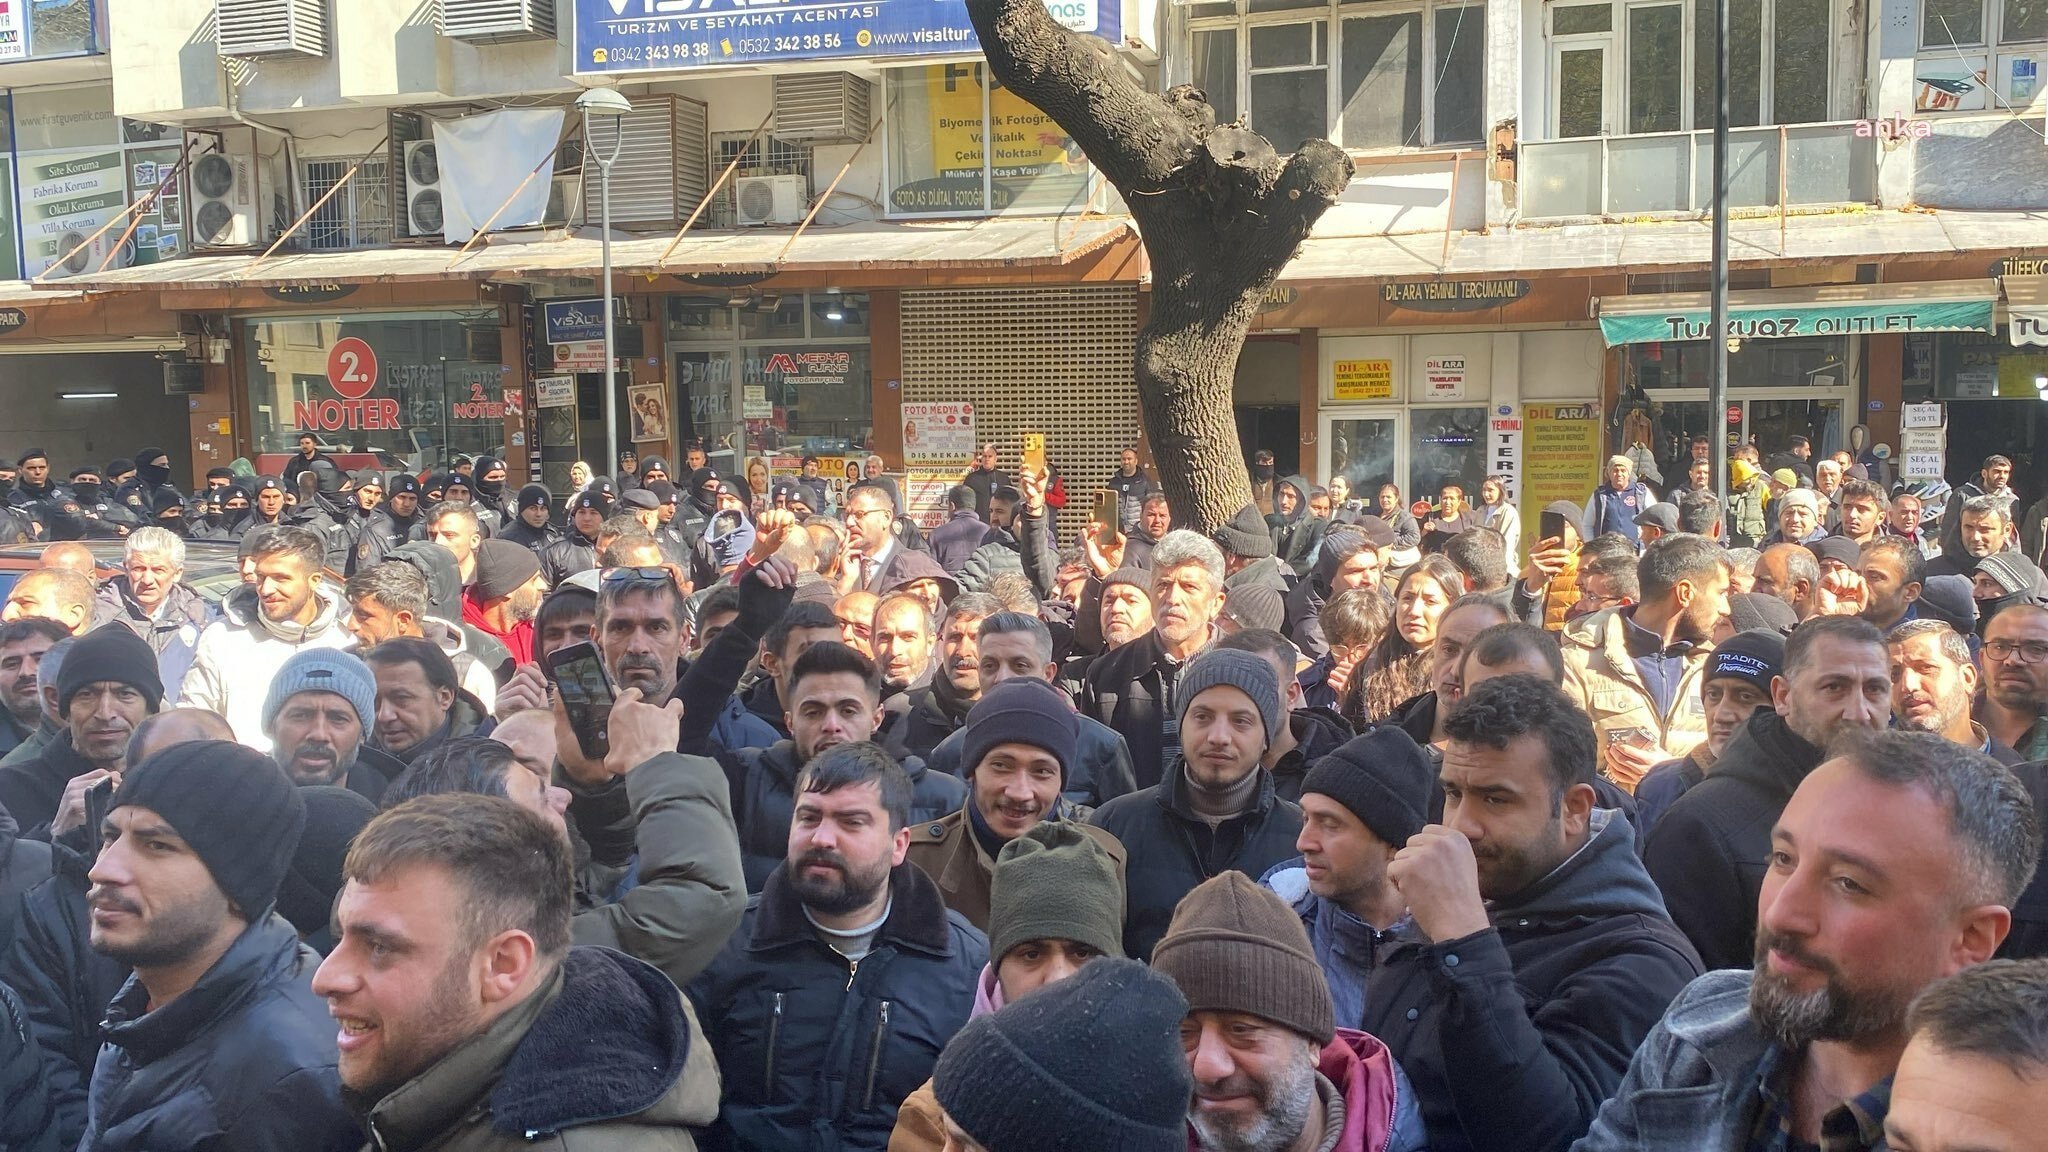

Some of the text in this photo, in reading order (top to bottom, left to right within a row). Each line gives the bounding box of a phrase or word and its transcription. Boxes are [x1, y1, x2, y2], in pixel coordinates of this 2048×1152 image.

[678, 20, 699, 32] VE
[706, 13, 785, 29] SEYAHAT
[792, 6, 879, 24] ACENTASI
[611, 47, 641, 63] 0342
[645, 45, 670, 61] 343
[673, 44, 688, 59] 98
[693, 42, 709, 57] 38
[739, 38, 769, 54] 0532
[775, 36, 800, 52] 342
[803, 34, 820, 50] 38
[824, 33, 841, 48] 56
[996, 148, 1042, 160] Noktası
[49, 160, 99, 177] Site Koruma
[992, 167, 1017, 178] Kaşe
[33, 179, 98, 198] Fabrika Koruma
[896, 191, 915, 206] FOTO
[49, 199, 104, 216] Okul Koruma
[62, 217, 95, 231] Koruma
[339, 351, 369, 383] 2.
[1427, 360, 1464, 369] DİL ARA
[470, 383, 488, 401] 2.
[294, 398, 402, 431] NOTER
[453, 402, 504, 419] NOTER
[904, 405, 959, 415] FOTO MEDYA
[1529, 406, 1553, 419] DİL
[1912, 406, 1926, 414] SEÇ
[1912, 415, 1927, 423] 350
[911, 451, 967, 461] DIŞ MEKAN
[1910, 456, 1927, 465] SEÇ
[1909, 467, 1940, 475] 350 TL
